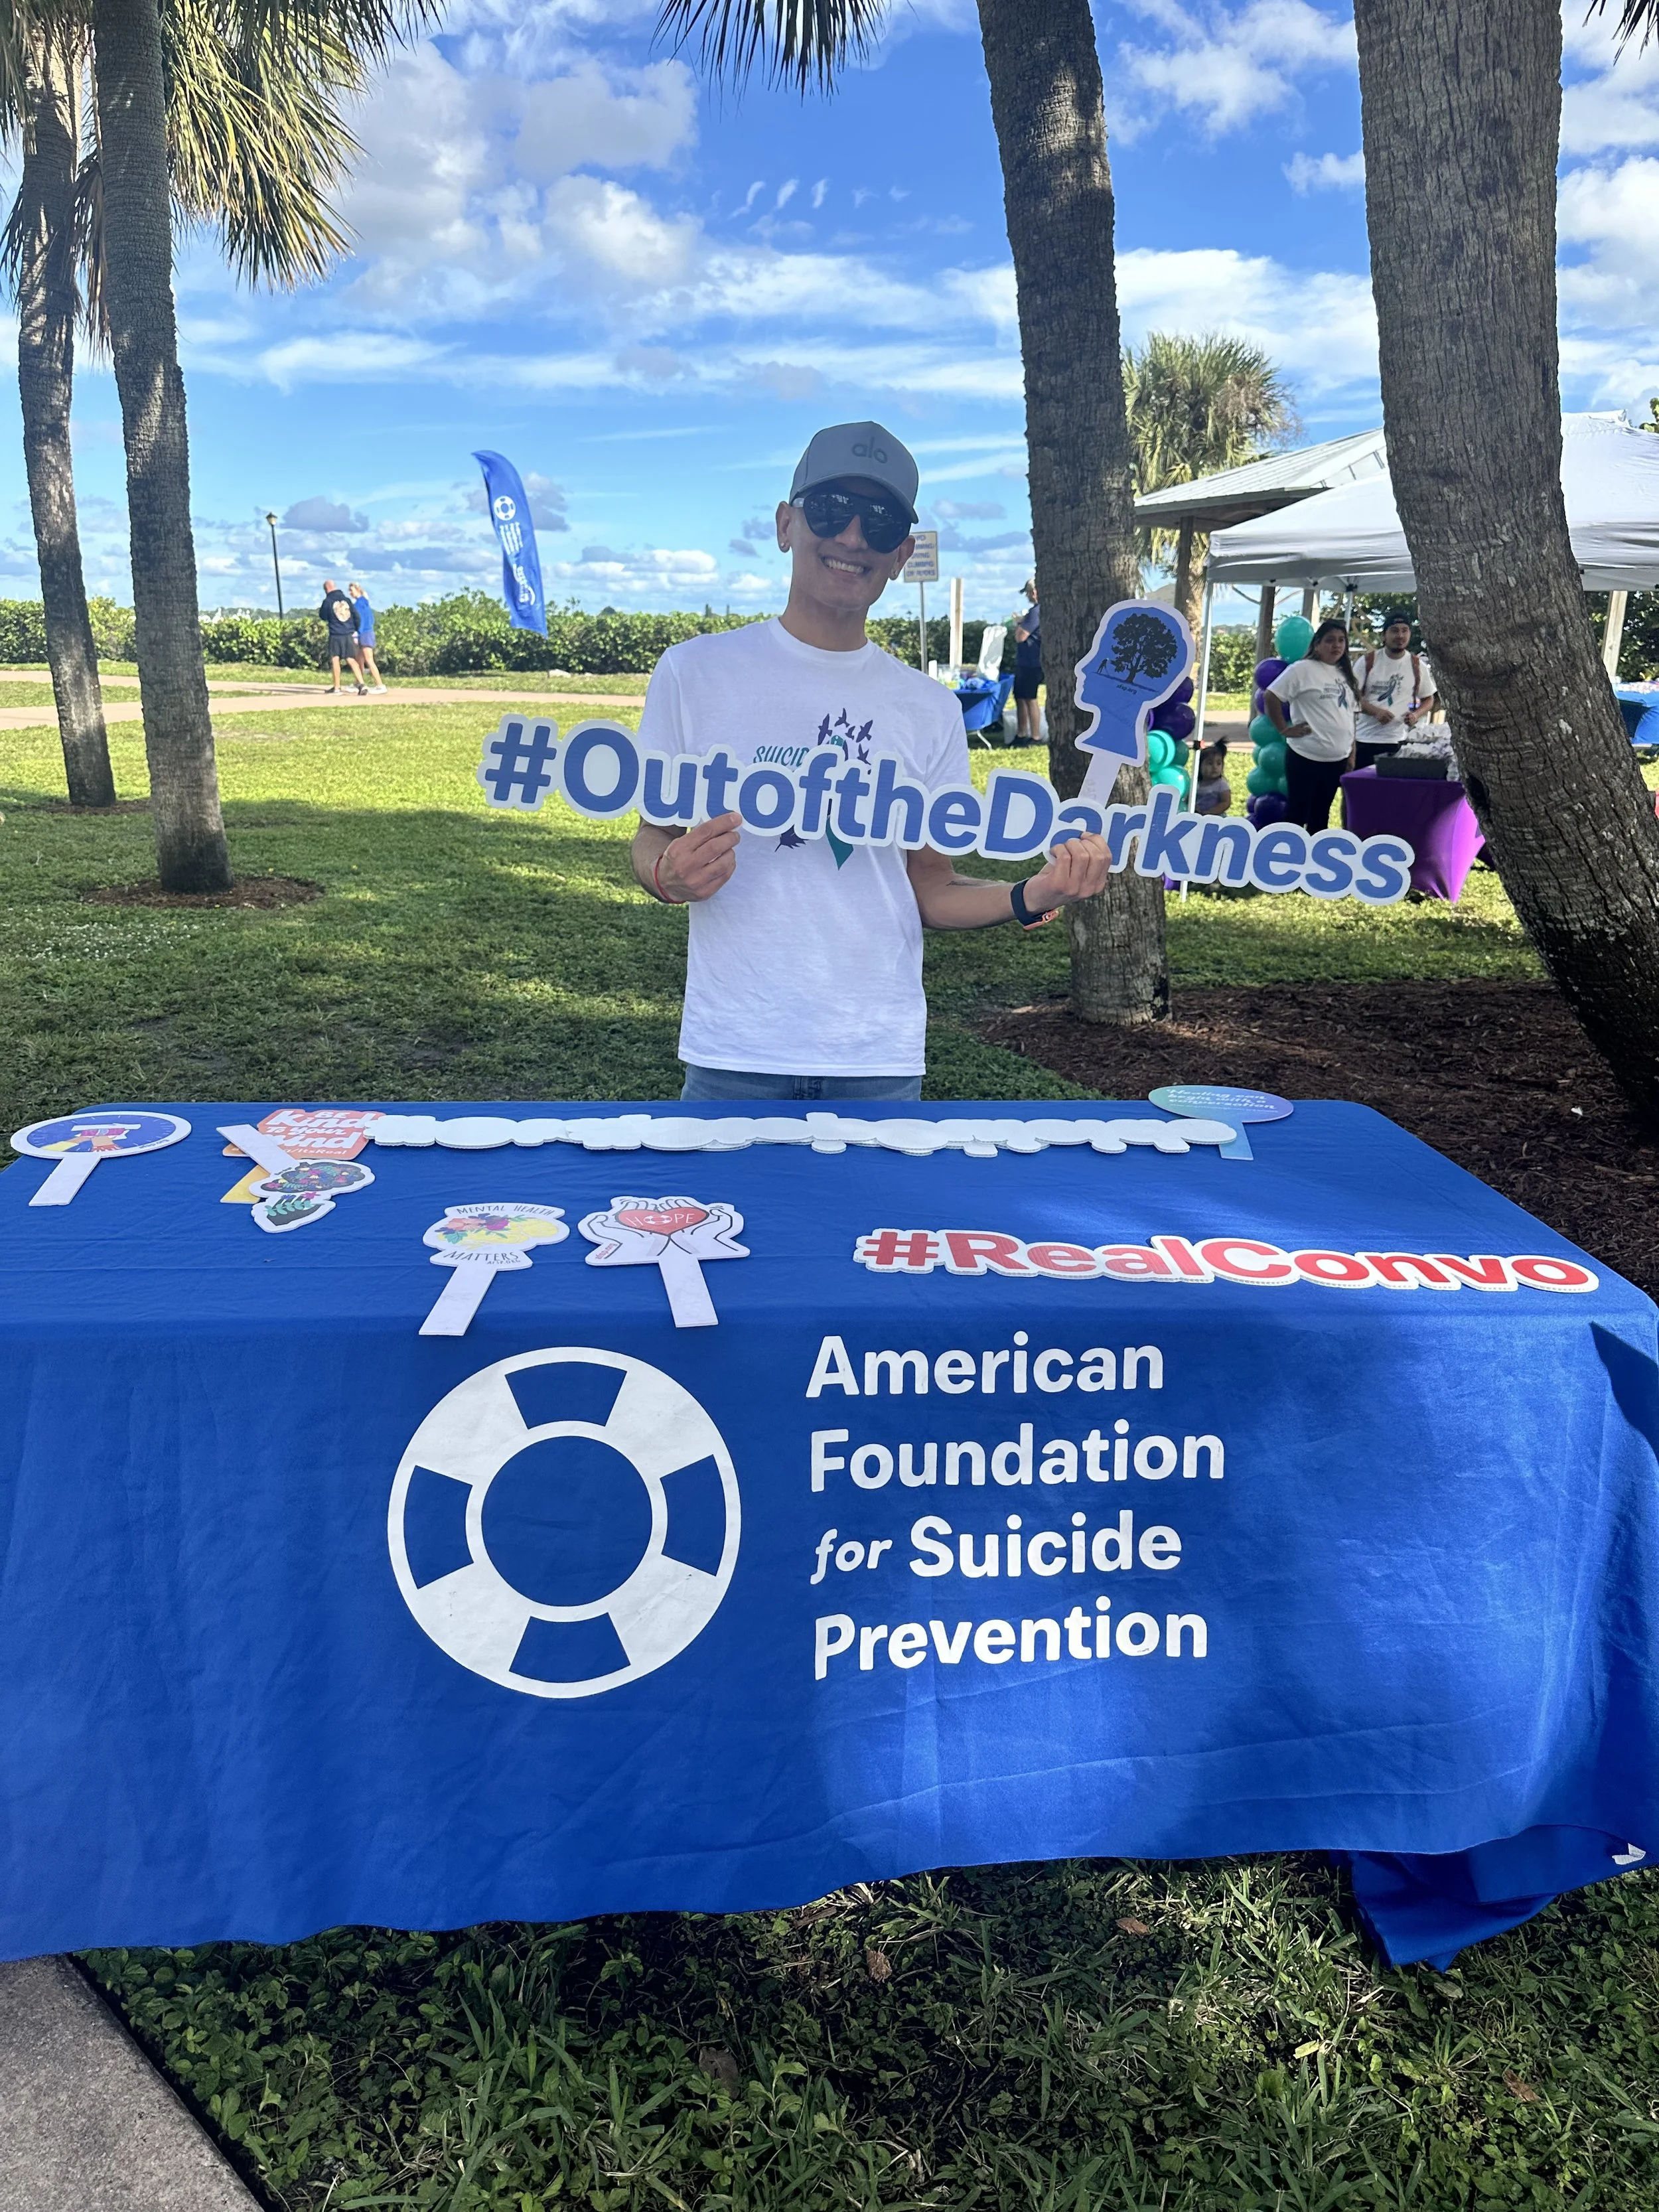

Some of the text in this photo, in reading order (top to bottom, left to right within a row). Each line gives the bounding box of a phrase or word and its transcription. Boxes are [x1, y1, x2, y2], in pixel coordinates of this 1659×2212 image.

[851, 436, 888, 464] alo
[753, 745, 810, 769] SUICID
[484, 721, 1406, 899] #OutoftheDarkness
[456, 1205, 555, 1215] MENTAL HEALTH
[443, 1250, 519, 1262] MATTERS
[864, 1232, 1589, 1286] #RealConvo
[806, 1331, 1164, 1398] American
[811, 1418, 1225, 1493] Foundation
[810, 1509, 1183, 1585] for Suicide
[814, 1595, 1208, 1681] Prevention
